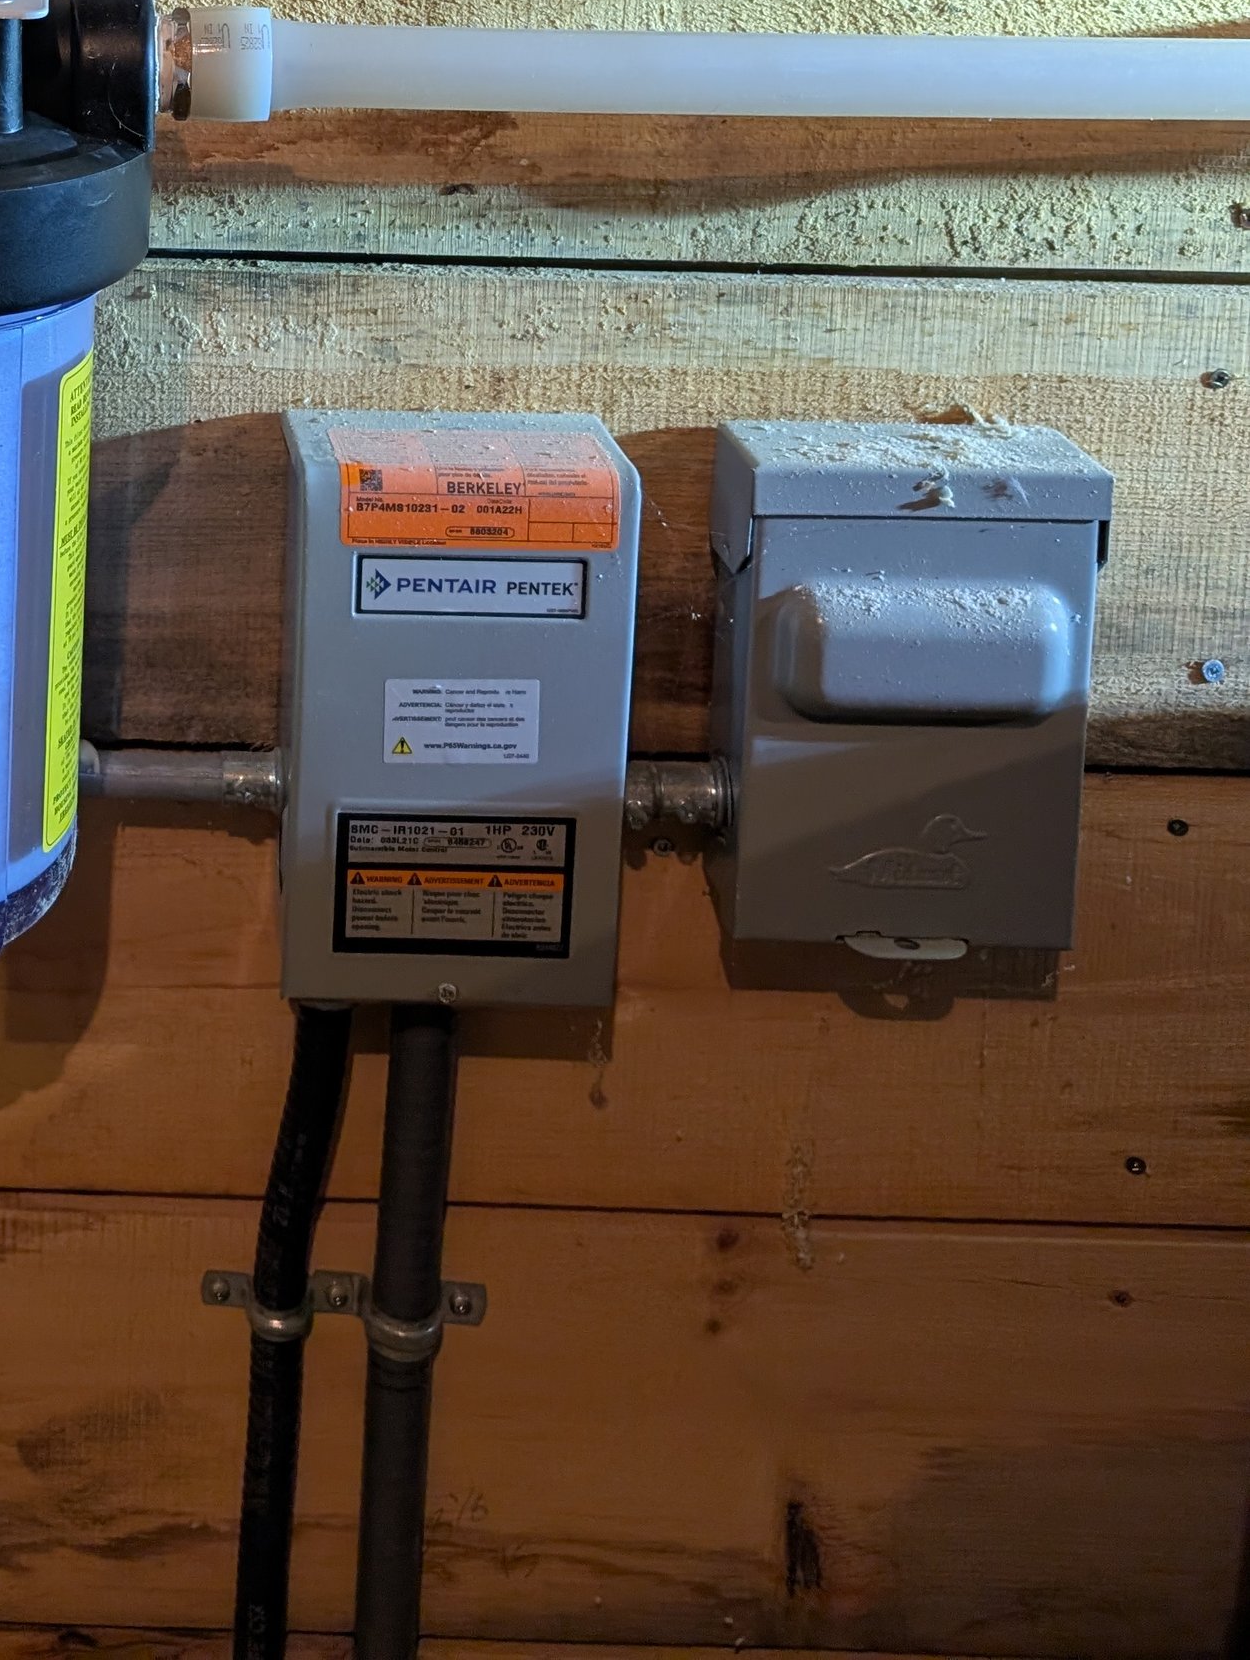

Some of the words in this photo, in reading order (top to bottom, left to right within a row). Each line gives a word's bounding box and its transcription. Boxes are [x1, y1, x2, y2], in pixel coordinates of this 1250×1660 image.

[447, 481, 521, 495] BERKELEY
[397, 578, 496, 594] PENTAIR
[485, 826, 512, 836] 1HP
[522, 826, 555, 836] 230V
